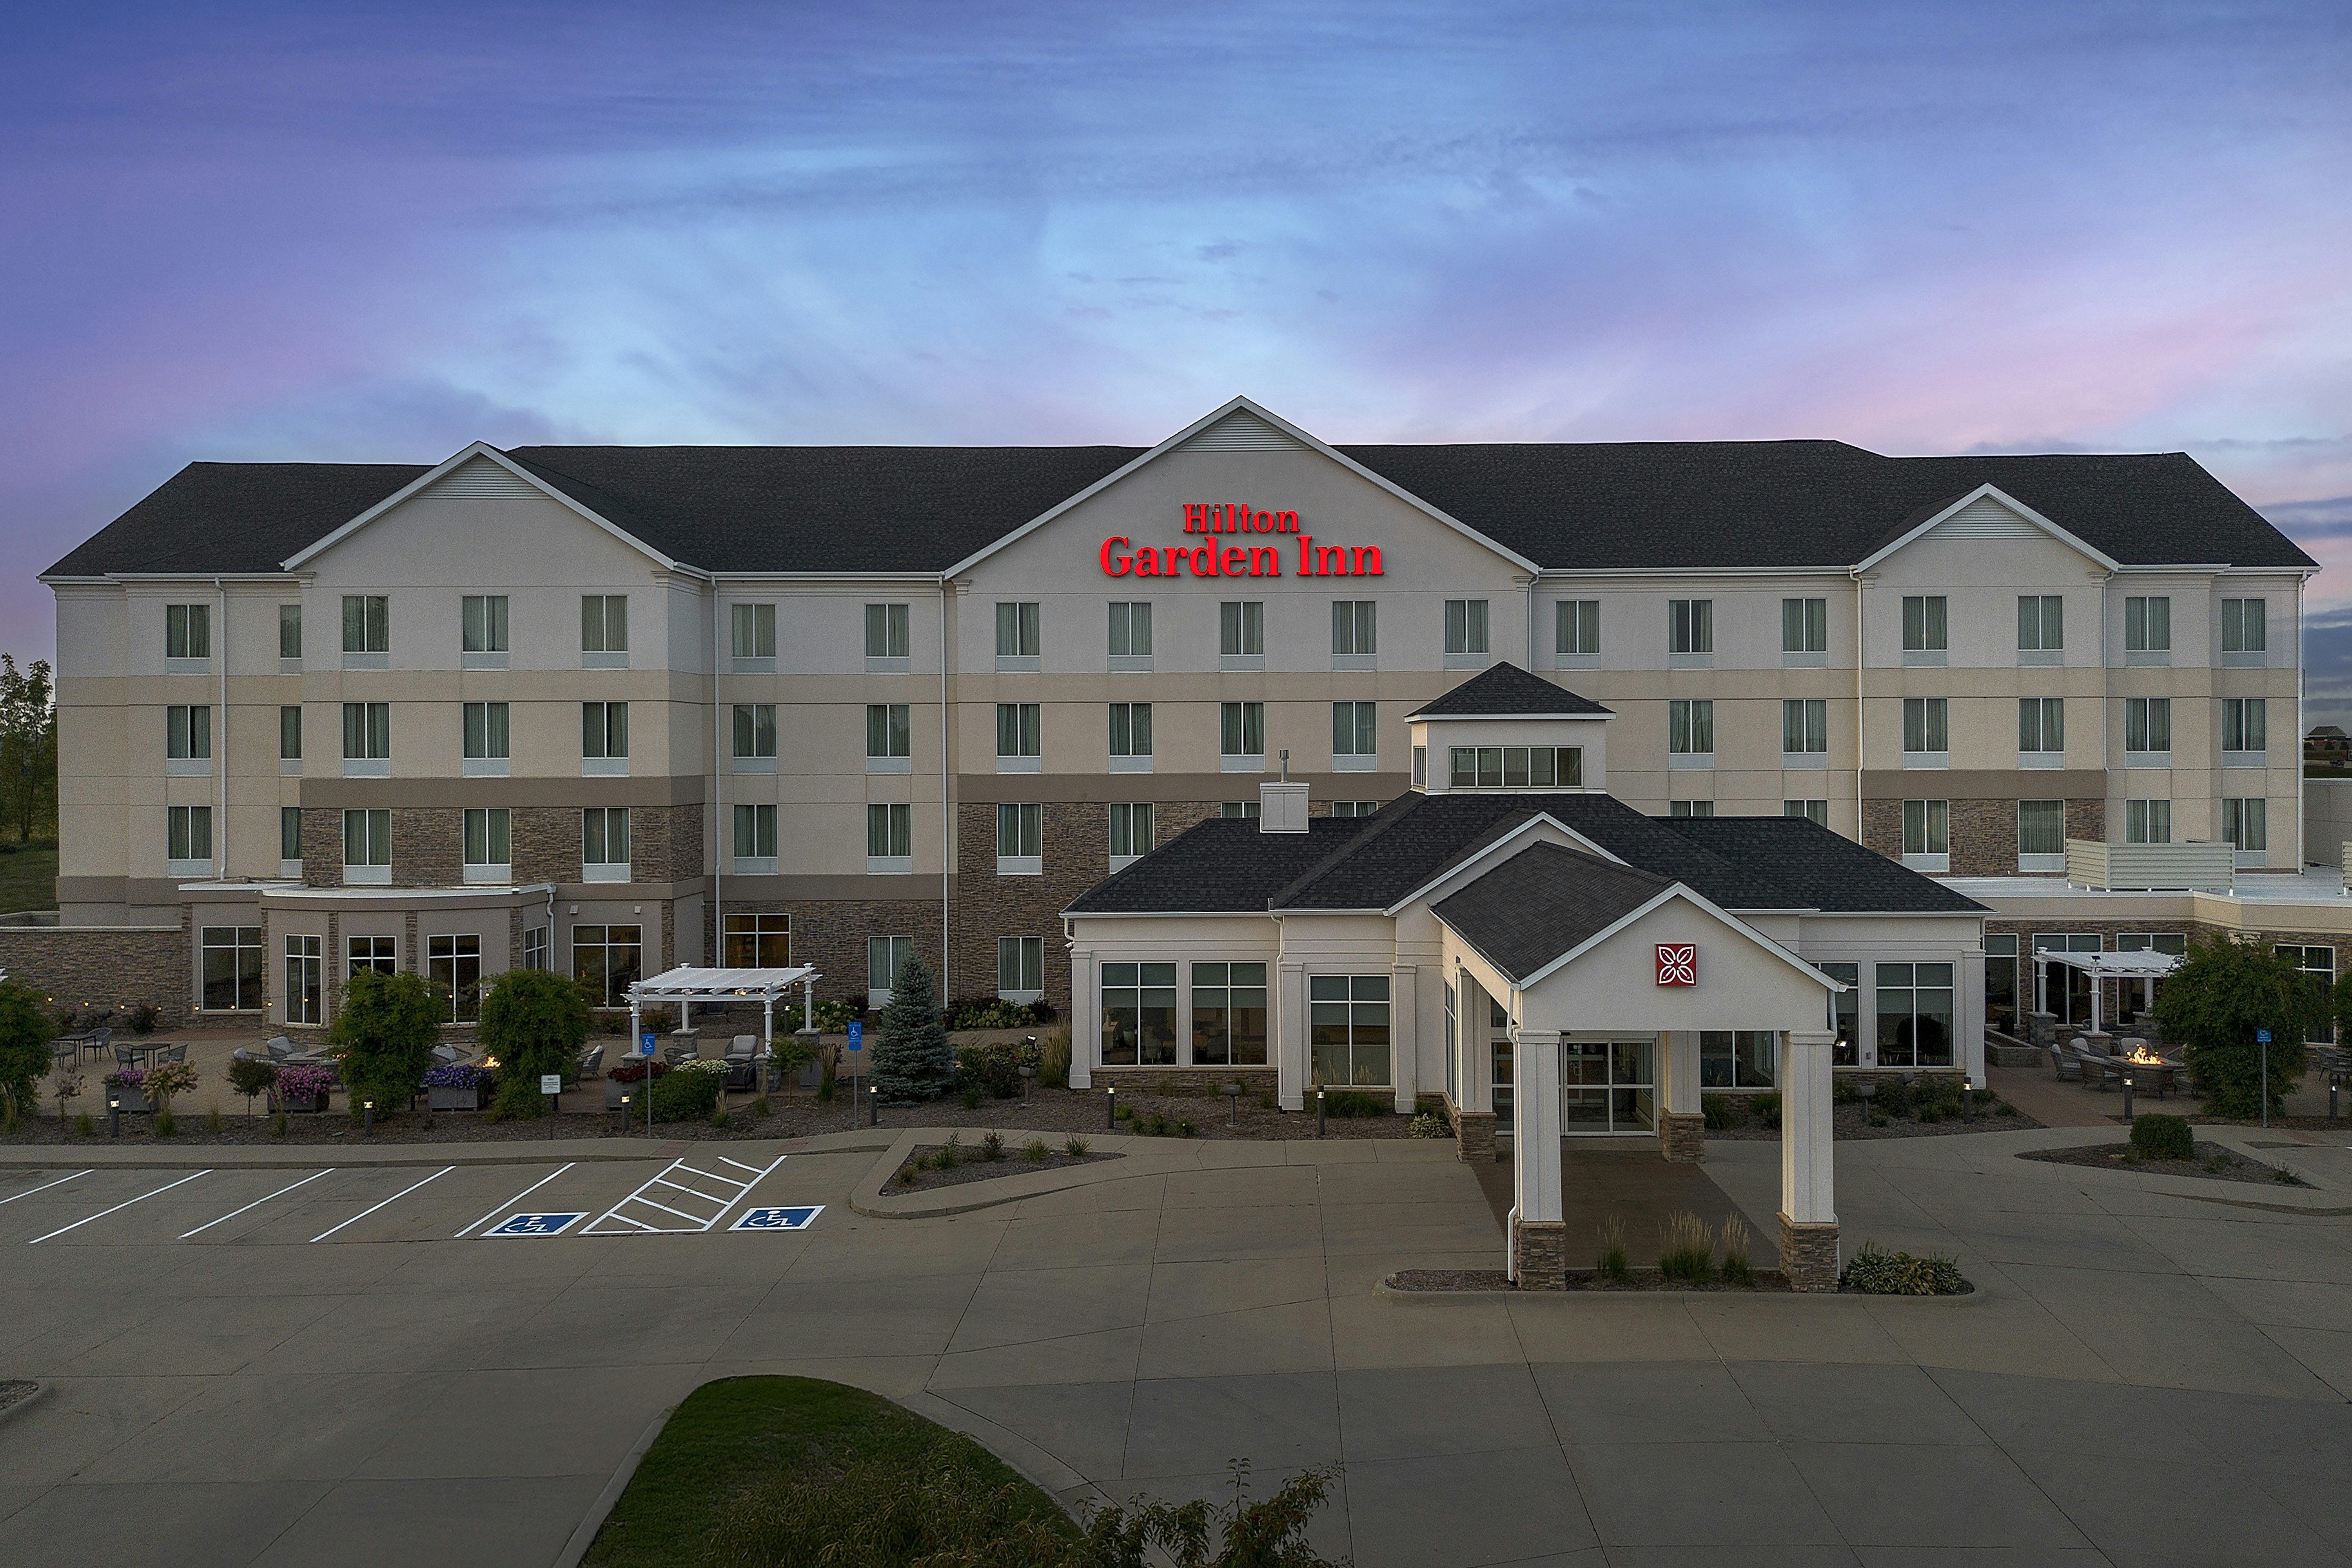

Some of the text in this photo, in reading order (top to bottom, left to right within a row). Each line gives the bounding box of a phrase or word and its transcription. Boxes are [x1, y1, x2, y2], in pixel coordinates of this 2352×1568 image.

[1182, 503, 1300, 532] Hilton
[1099, 535, 1384, 577] Garden Inn
